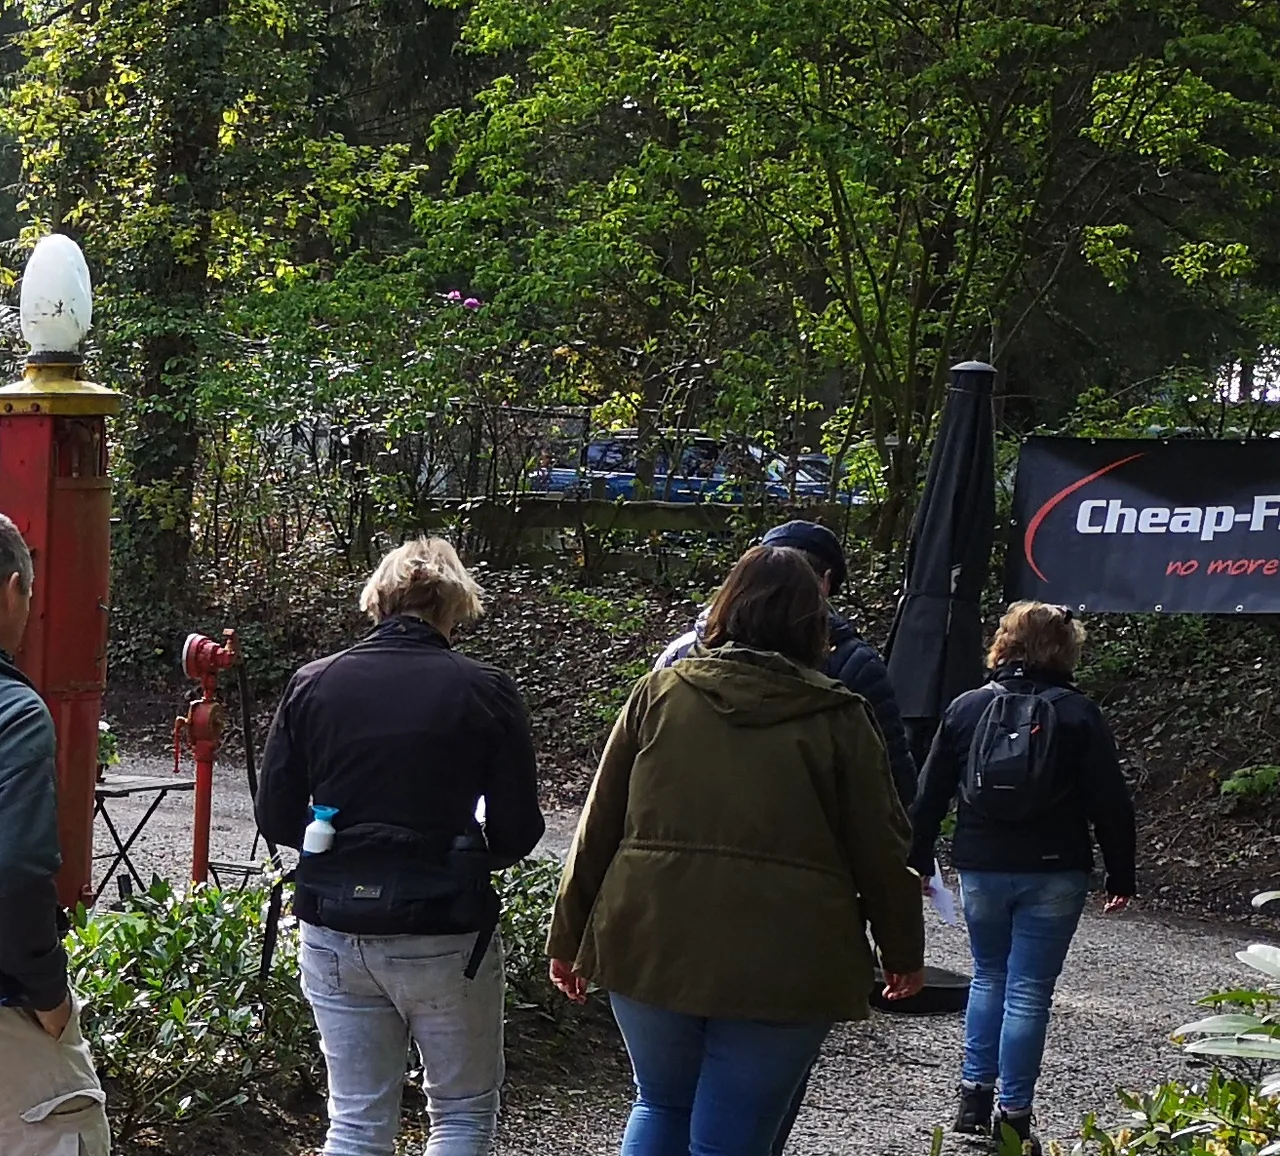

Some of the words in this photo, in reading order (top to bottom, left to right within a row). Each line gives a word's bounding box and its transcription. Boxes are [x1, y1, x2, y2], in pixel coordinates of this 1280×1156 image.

[1076, 494, 1280, 541] Cheap-F
[1164, 558, 1199, 577] no
[1206, 558, 1279, 576] more
